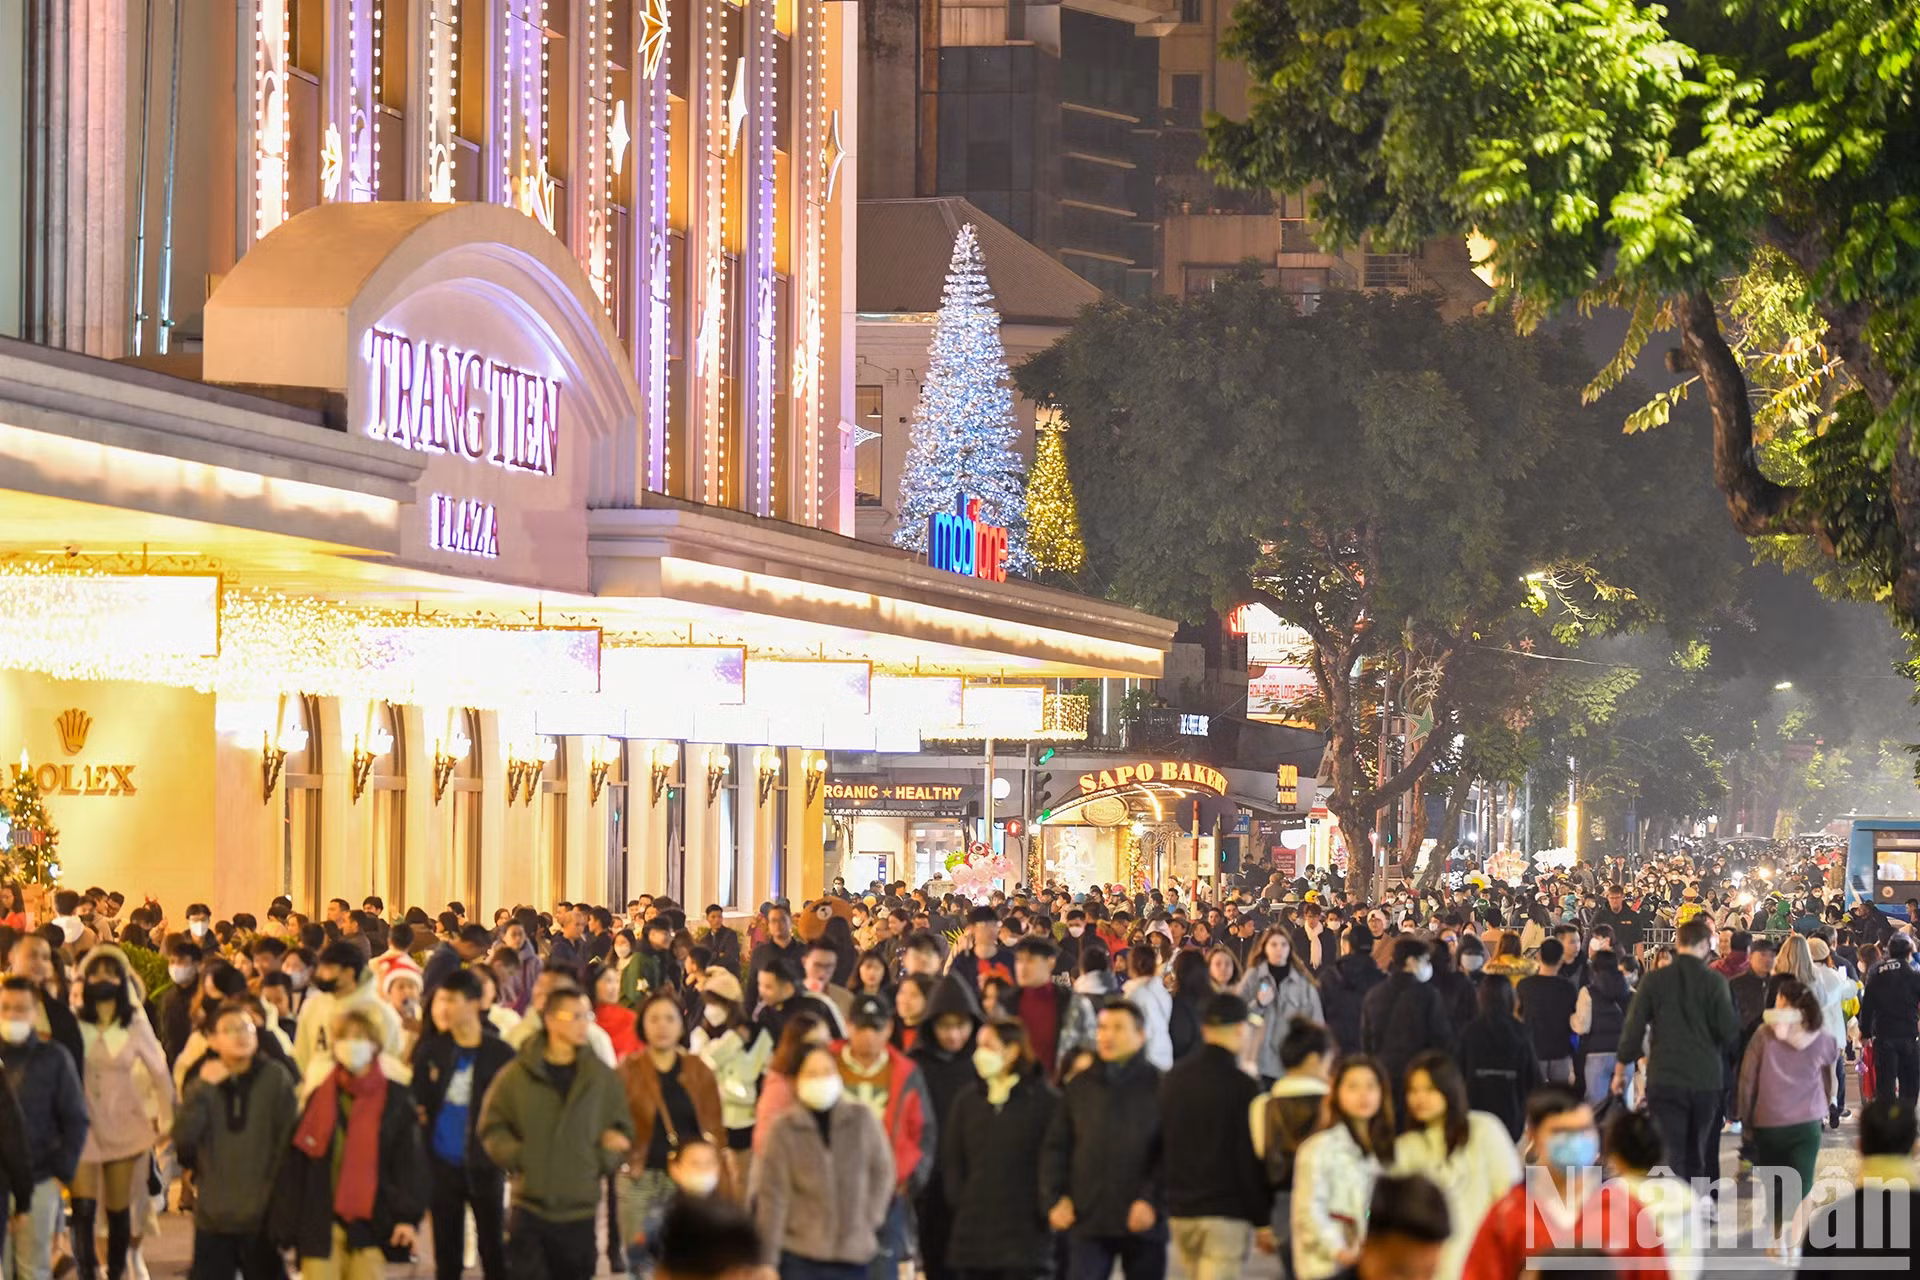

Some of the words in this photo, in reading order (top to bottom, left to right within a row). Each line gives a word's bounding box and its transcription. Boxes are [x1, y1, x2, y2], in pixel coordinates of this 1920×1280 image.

[364, 323, 484, 461] TRANG
[430, 493, 500, 558] PLAZA
[824, 784, 879, 799] RGANIC
[895, 786, 962, 800] HEALTHY
[1079, 763, 1154, 794] SAPO
[1160, 762, 1229, 796] BAKERY
